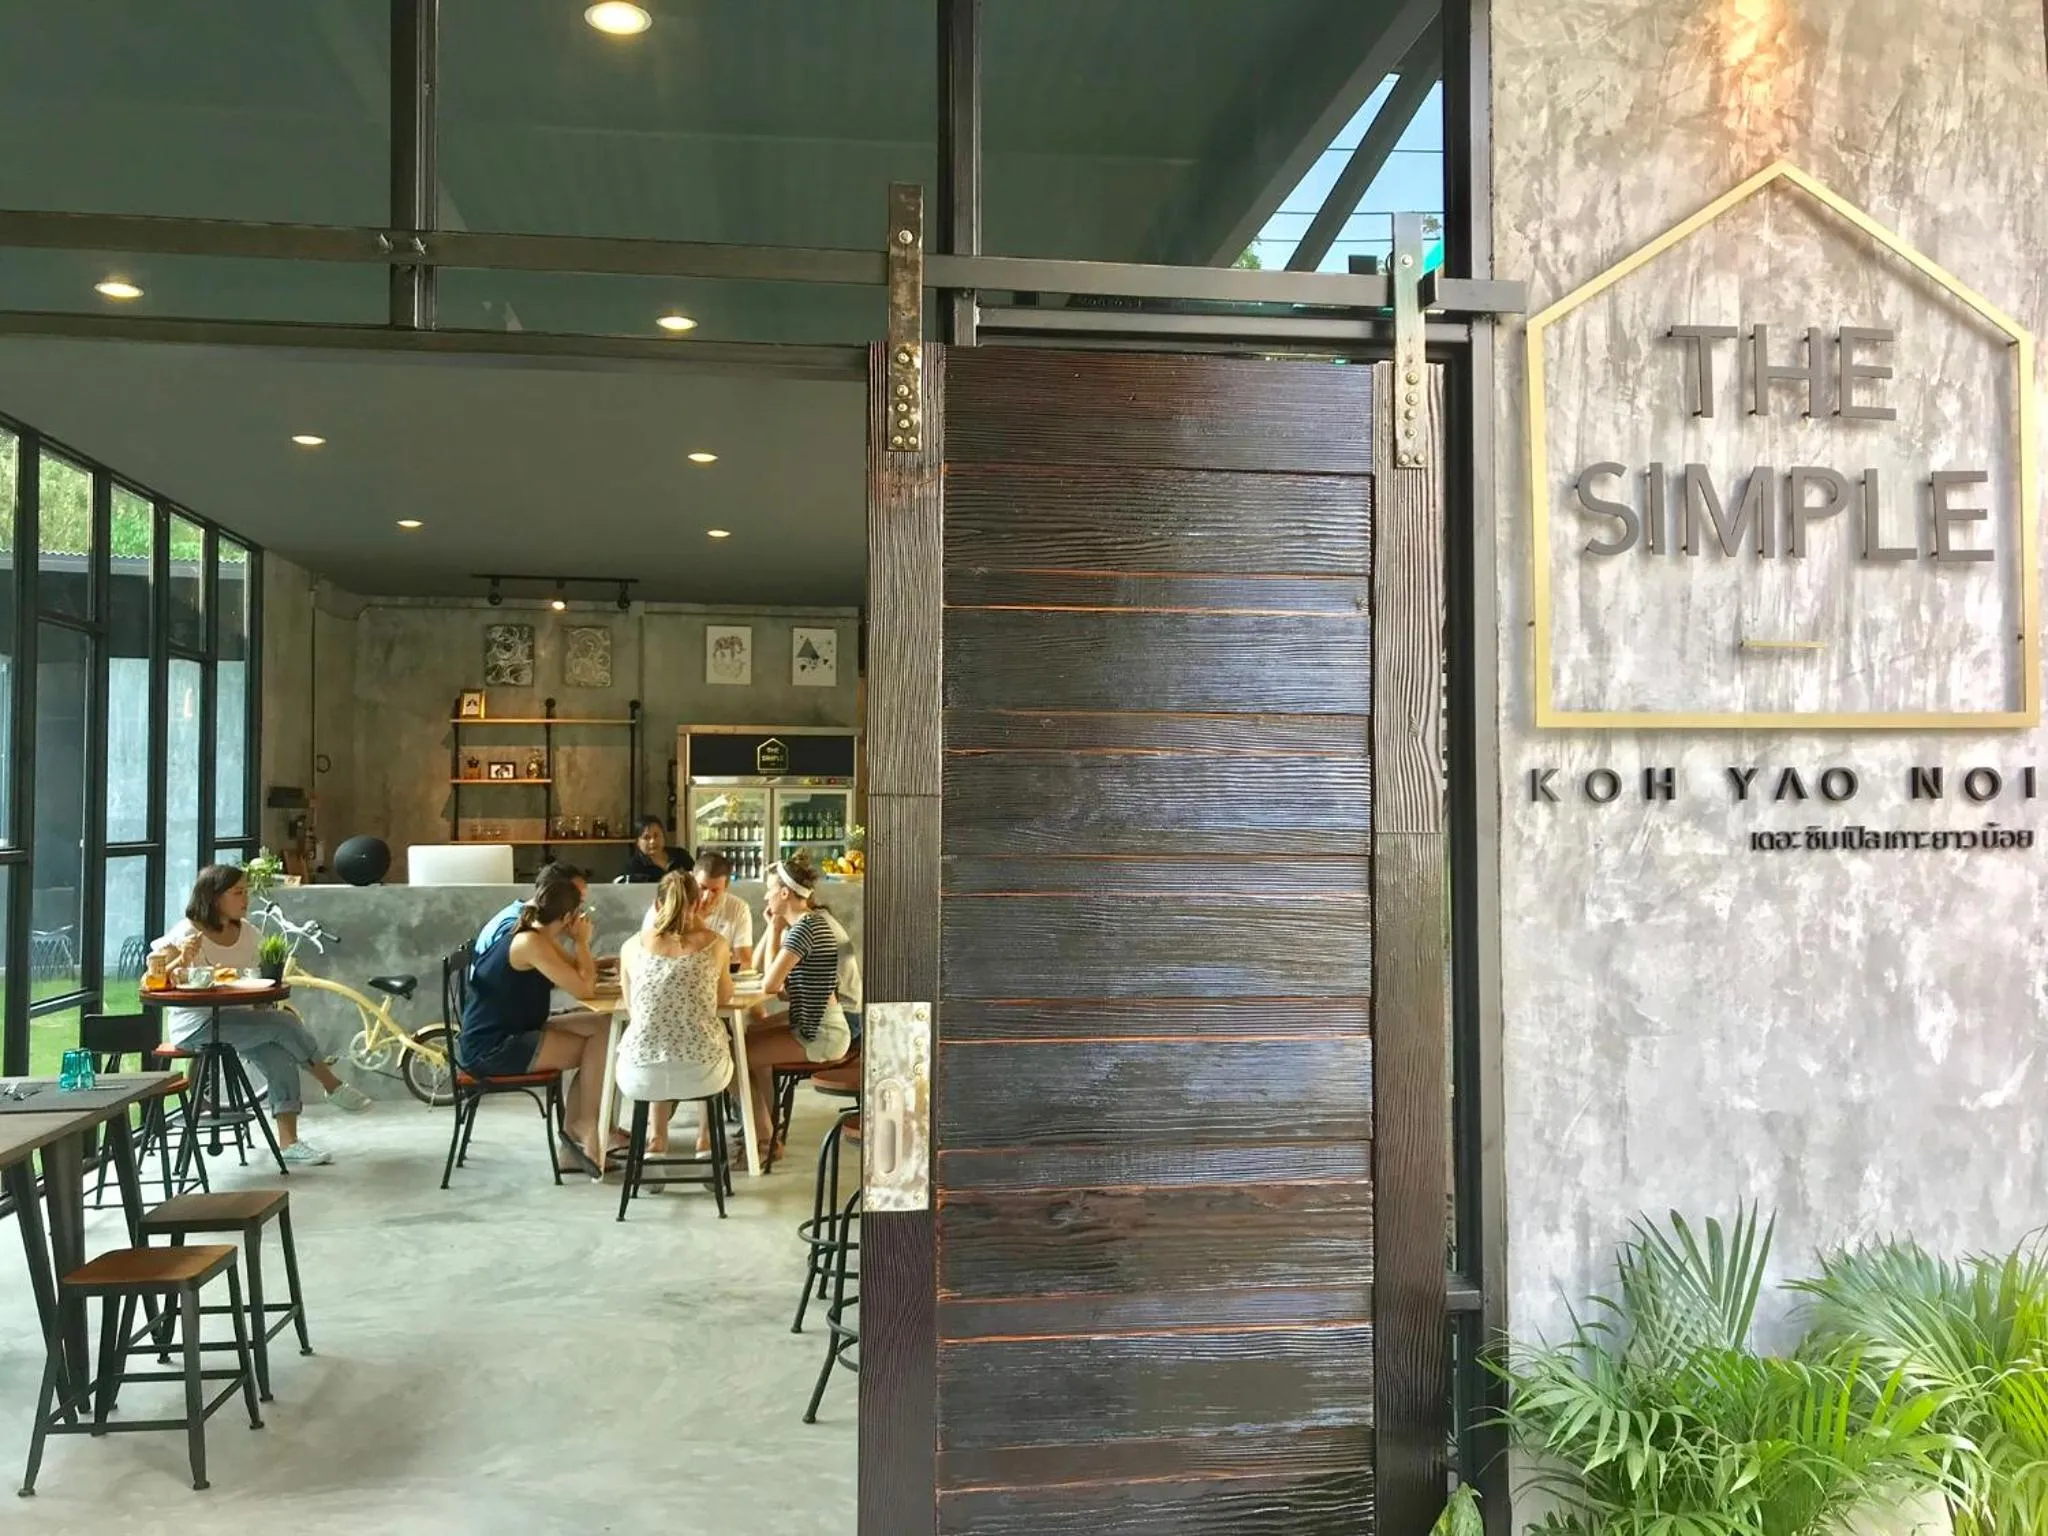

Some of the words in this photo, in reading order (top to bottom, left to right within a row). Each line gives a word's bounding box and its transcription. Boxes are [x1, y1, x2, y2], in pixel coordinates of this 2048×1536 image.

[1668, 324, 1897, 421] THE
[1575, 461, 1995, 562] SIMPLE
[1529, 767, 1676, 804] KOH
[1727, 766, 1859, 801] YAO
[1910, 766, 2037, 801] NOI
